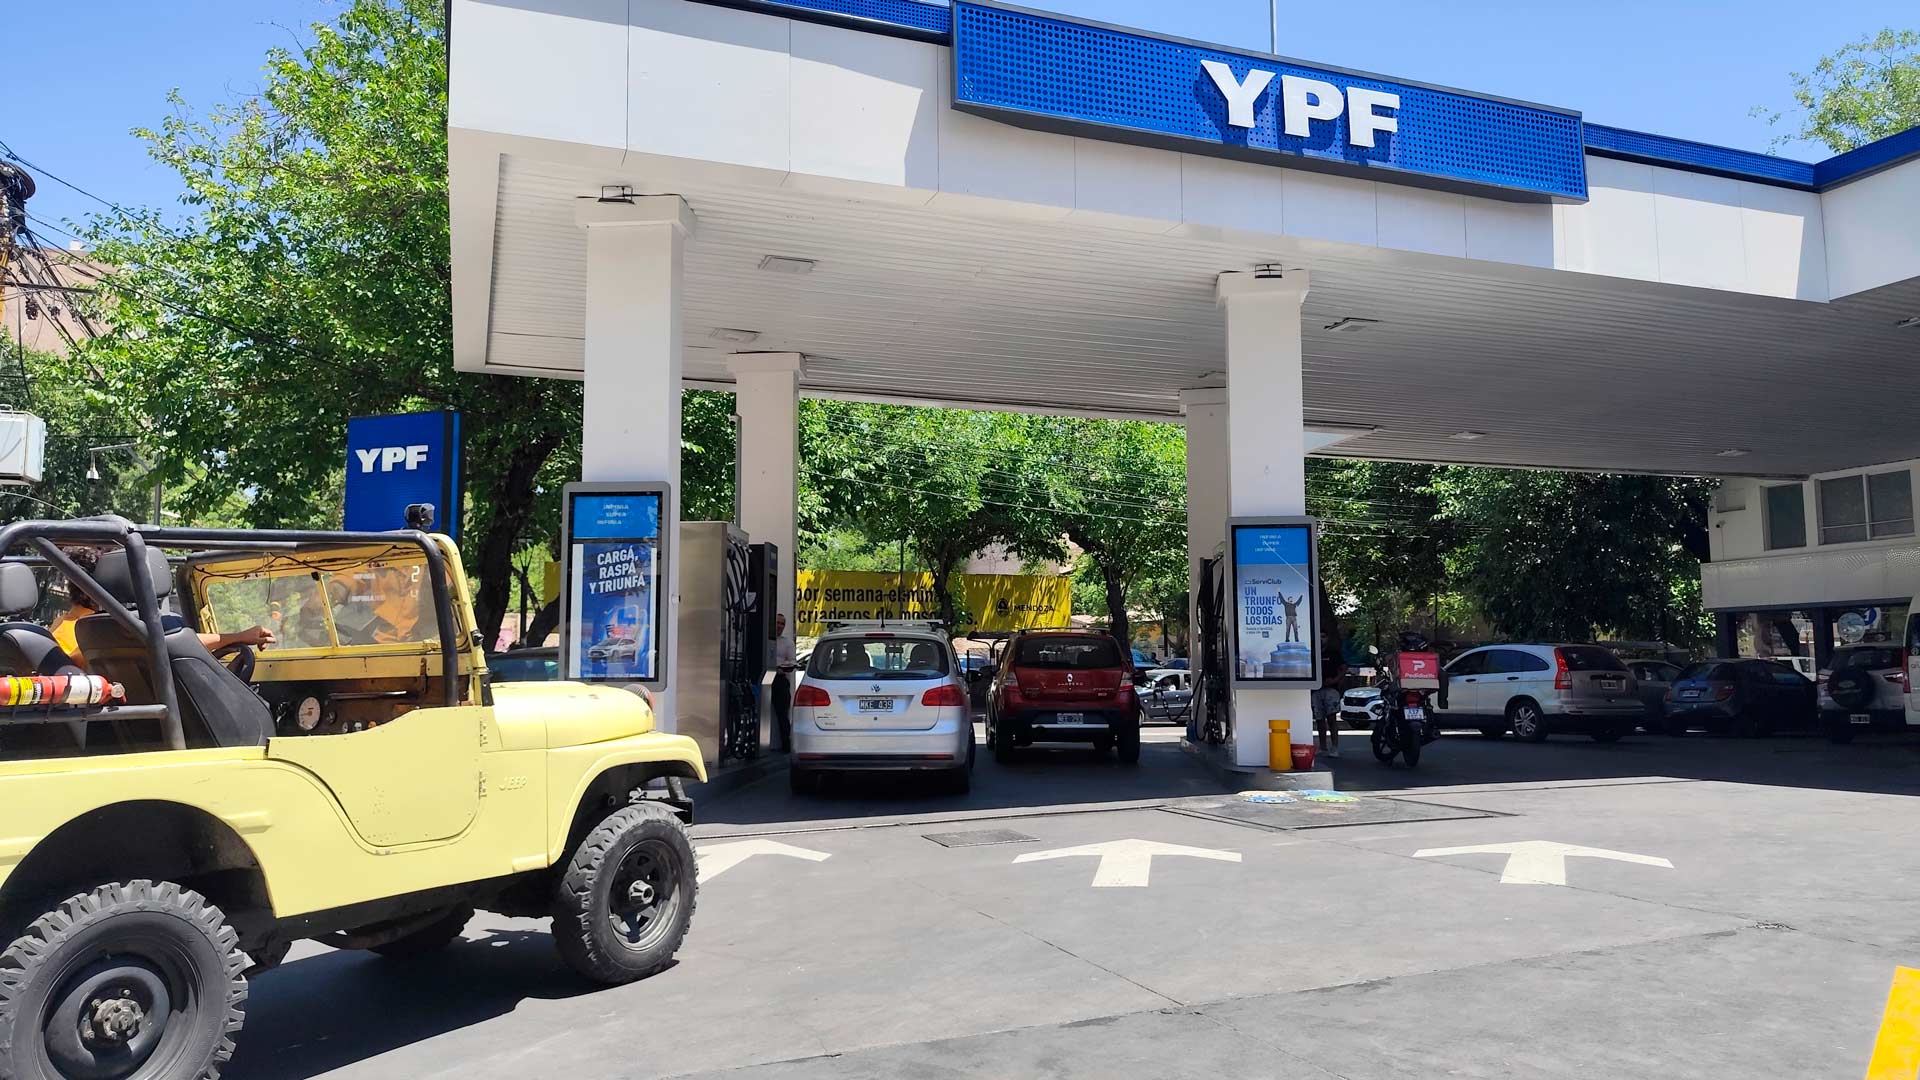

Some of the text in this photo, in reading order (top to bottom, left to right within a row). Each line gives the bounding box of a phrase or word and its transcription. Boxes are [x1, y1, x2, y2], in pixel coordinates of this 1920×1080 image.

[1200, 59, 1400, 148] YPF
[355, 444, 429, 473] YPF
[597, 545, 638, 566] CARGÁ,
[599, 560, 636, 579] RASPÁ
[589, 572, 645, 595] Y TRIUNFÁ
[1244, 586, 1257, 596] UN
[824, 588, 883, 602] semana
[1245, 596, 1282, 606] TRIUNFO
[798, 606, 869, 623] criaderos
[1013, 605, 1055, 613] MENDOZA
[1245, 606, 1273, 616] TODOS
[1245, 615, 1261, 625] LOS
[498, 775, 527, 791] JEEP
